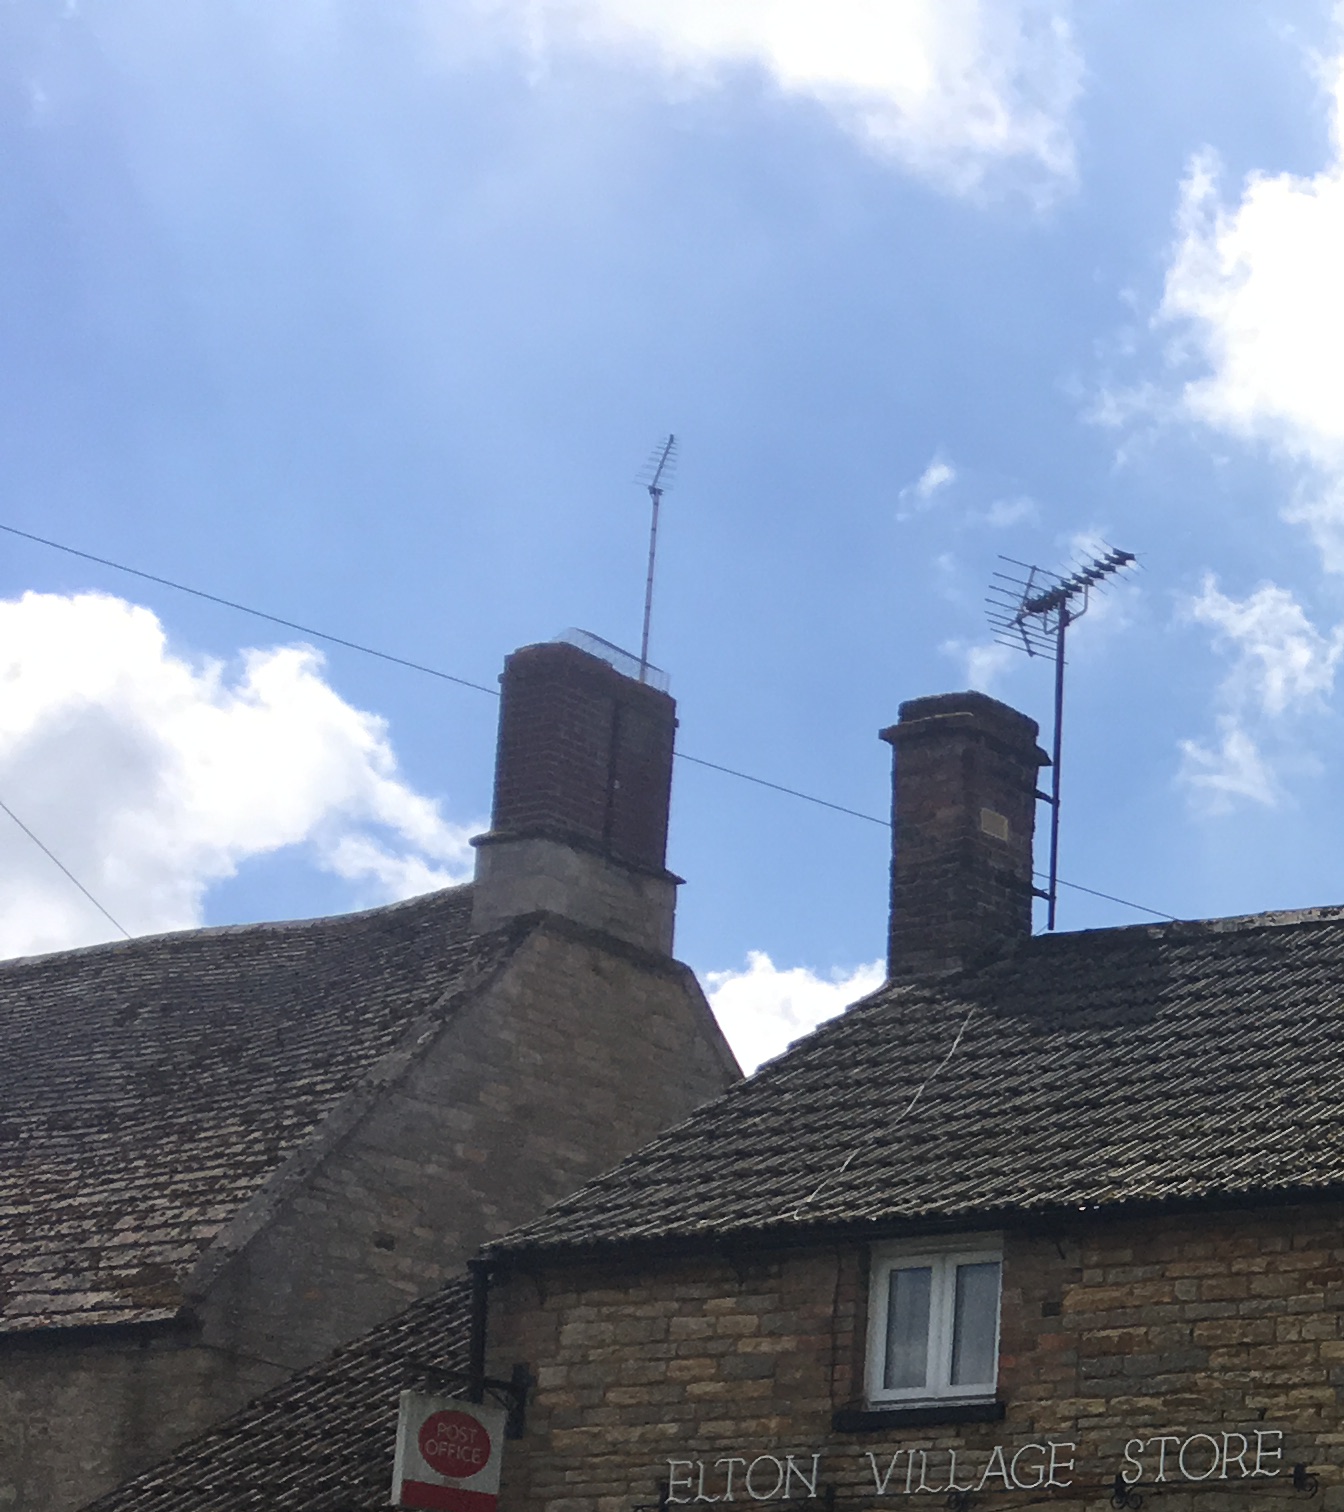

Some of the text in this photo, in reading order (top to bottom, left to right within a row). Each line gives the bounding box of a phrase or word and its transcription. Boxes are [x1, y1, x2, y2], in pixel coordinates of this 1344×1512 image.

[437, 1422, 478, 1444] POST
[424, 1439, 483, 1464] OFFICE
[665, 1430, 1284, 1505] ELTON VILLAGE STORE
